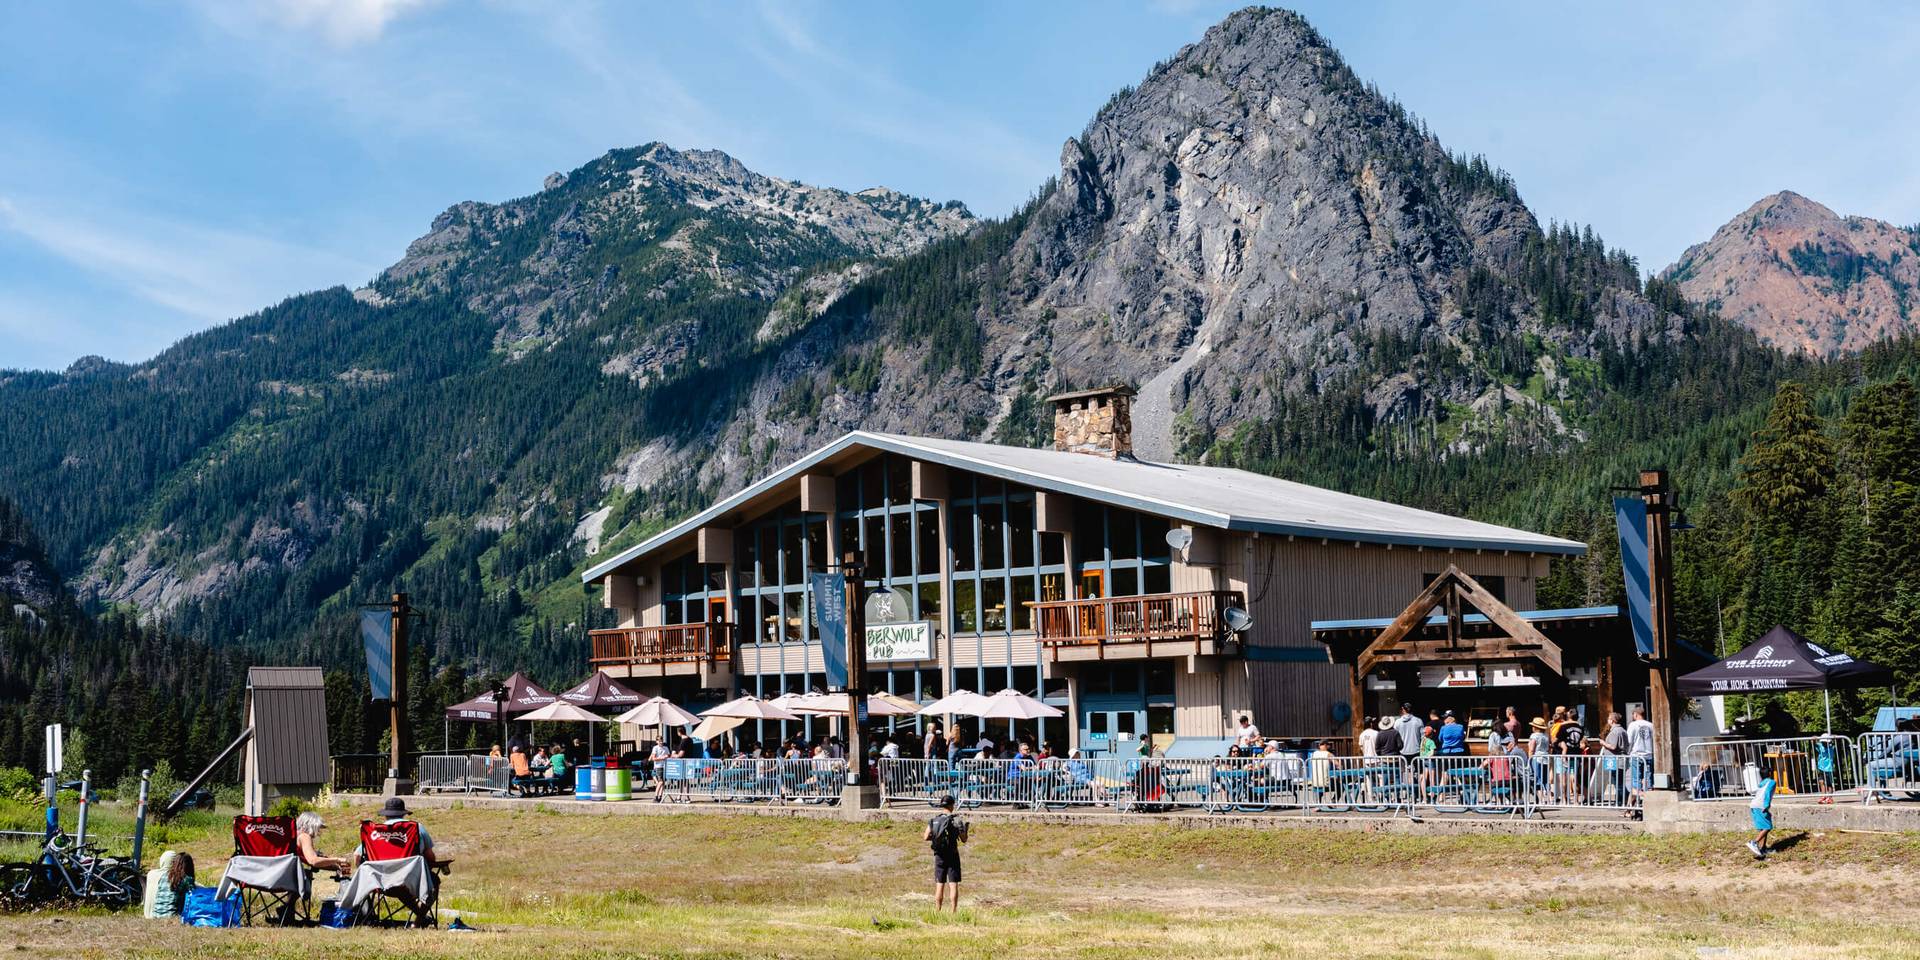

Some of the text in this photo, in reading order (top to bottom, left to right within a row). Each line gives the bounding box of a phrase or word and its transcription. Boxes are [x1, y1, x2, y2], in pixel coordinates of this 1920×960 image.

[825, 577, 833, 622] SUMMIT
[833, 588, 842, 622] WEST
[867, 625, 927, 646] BERWOLF
[873, 645, 893, 659] PUB
[1748, 659, 1795, 667] SUMMIT
[1711, 678, 1788, 691] YOUR HOME MOUNTAIN
[244, 822, 285, 836] Cougars
[370, 829, 408, 843] Cougars
